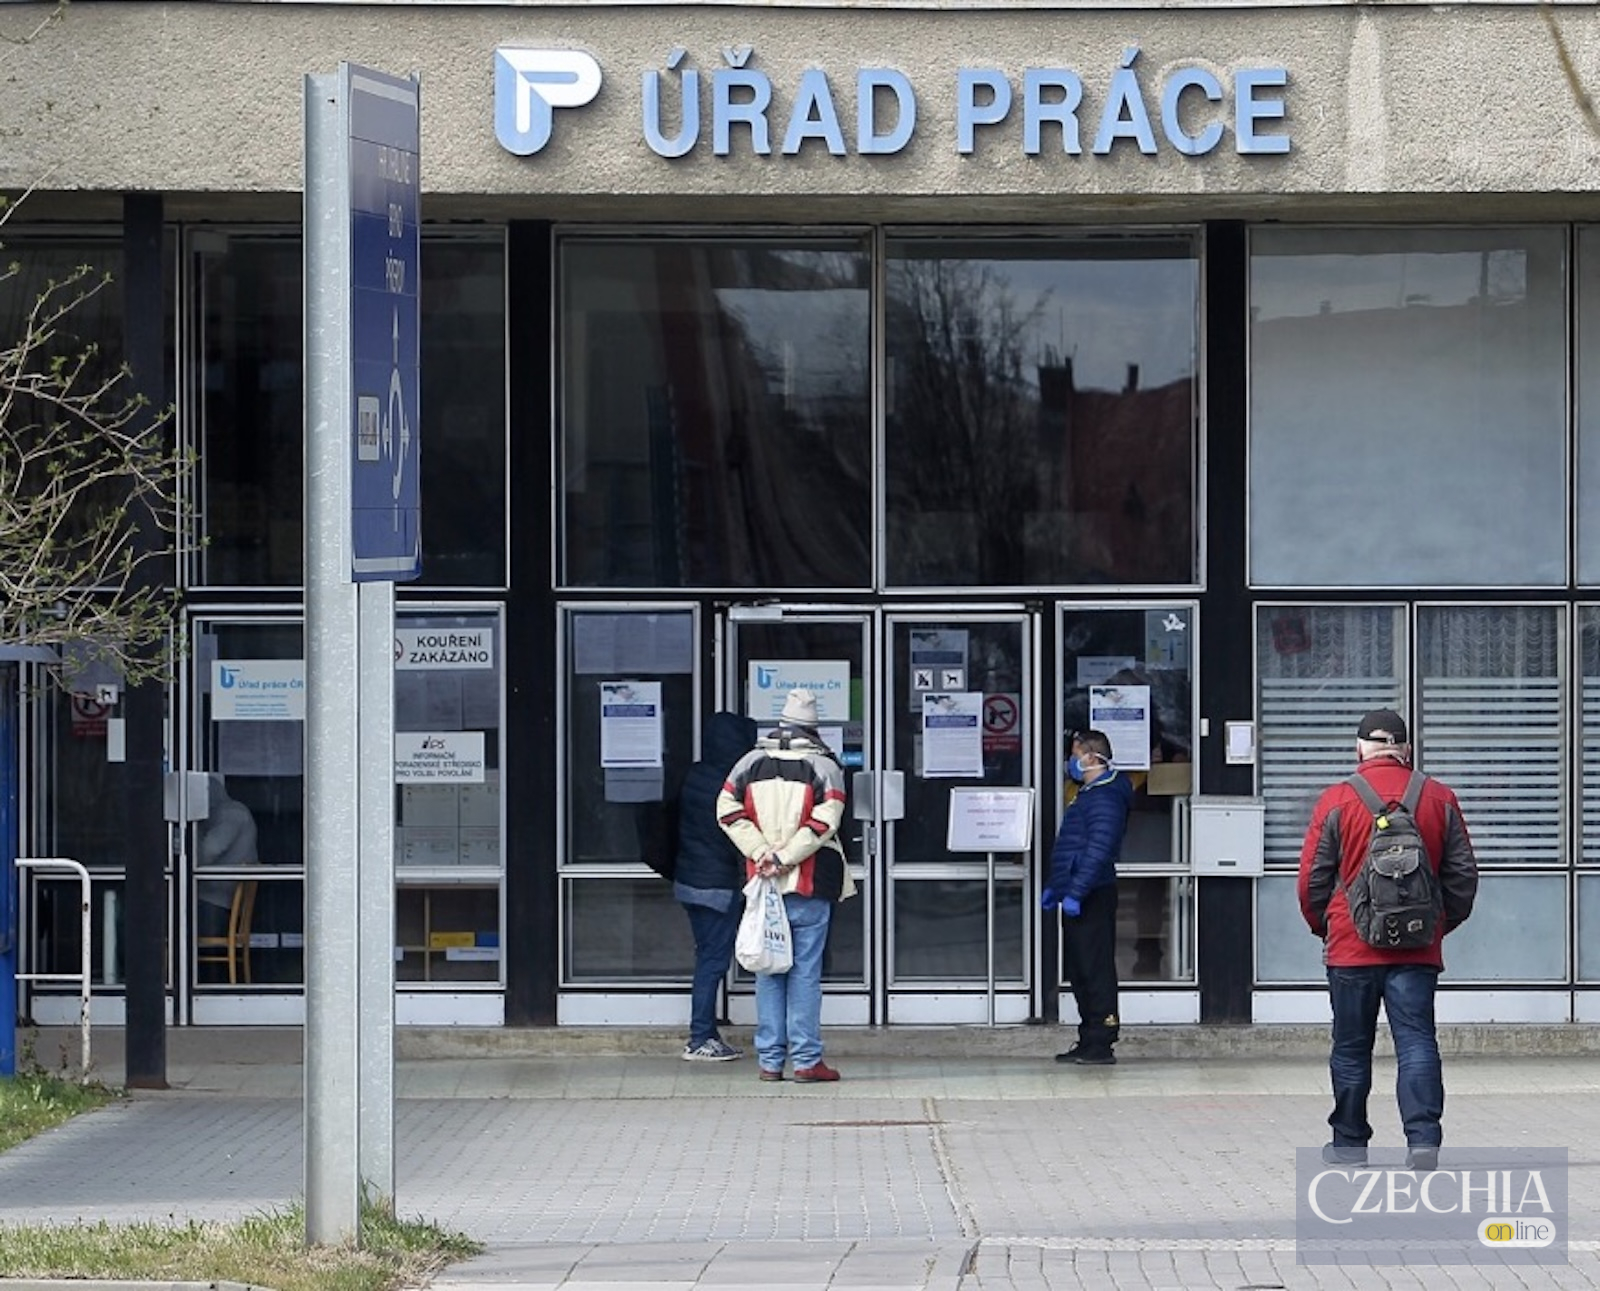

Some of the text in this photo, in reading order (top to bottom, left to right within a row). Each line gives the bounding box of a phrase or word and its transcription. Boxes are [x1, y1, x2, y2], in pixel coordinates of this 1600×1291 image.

[642, 46, 917, 158] ÚŘAD
[957, 46, 1291, 156] PRÁCE
[416, 632, 482, 648] KOUŘENÍ
[409, 649, 489, 664] ZAKÁZÁNO
[827, 679, 841, 690] ČR
